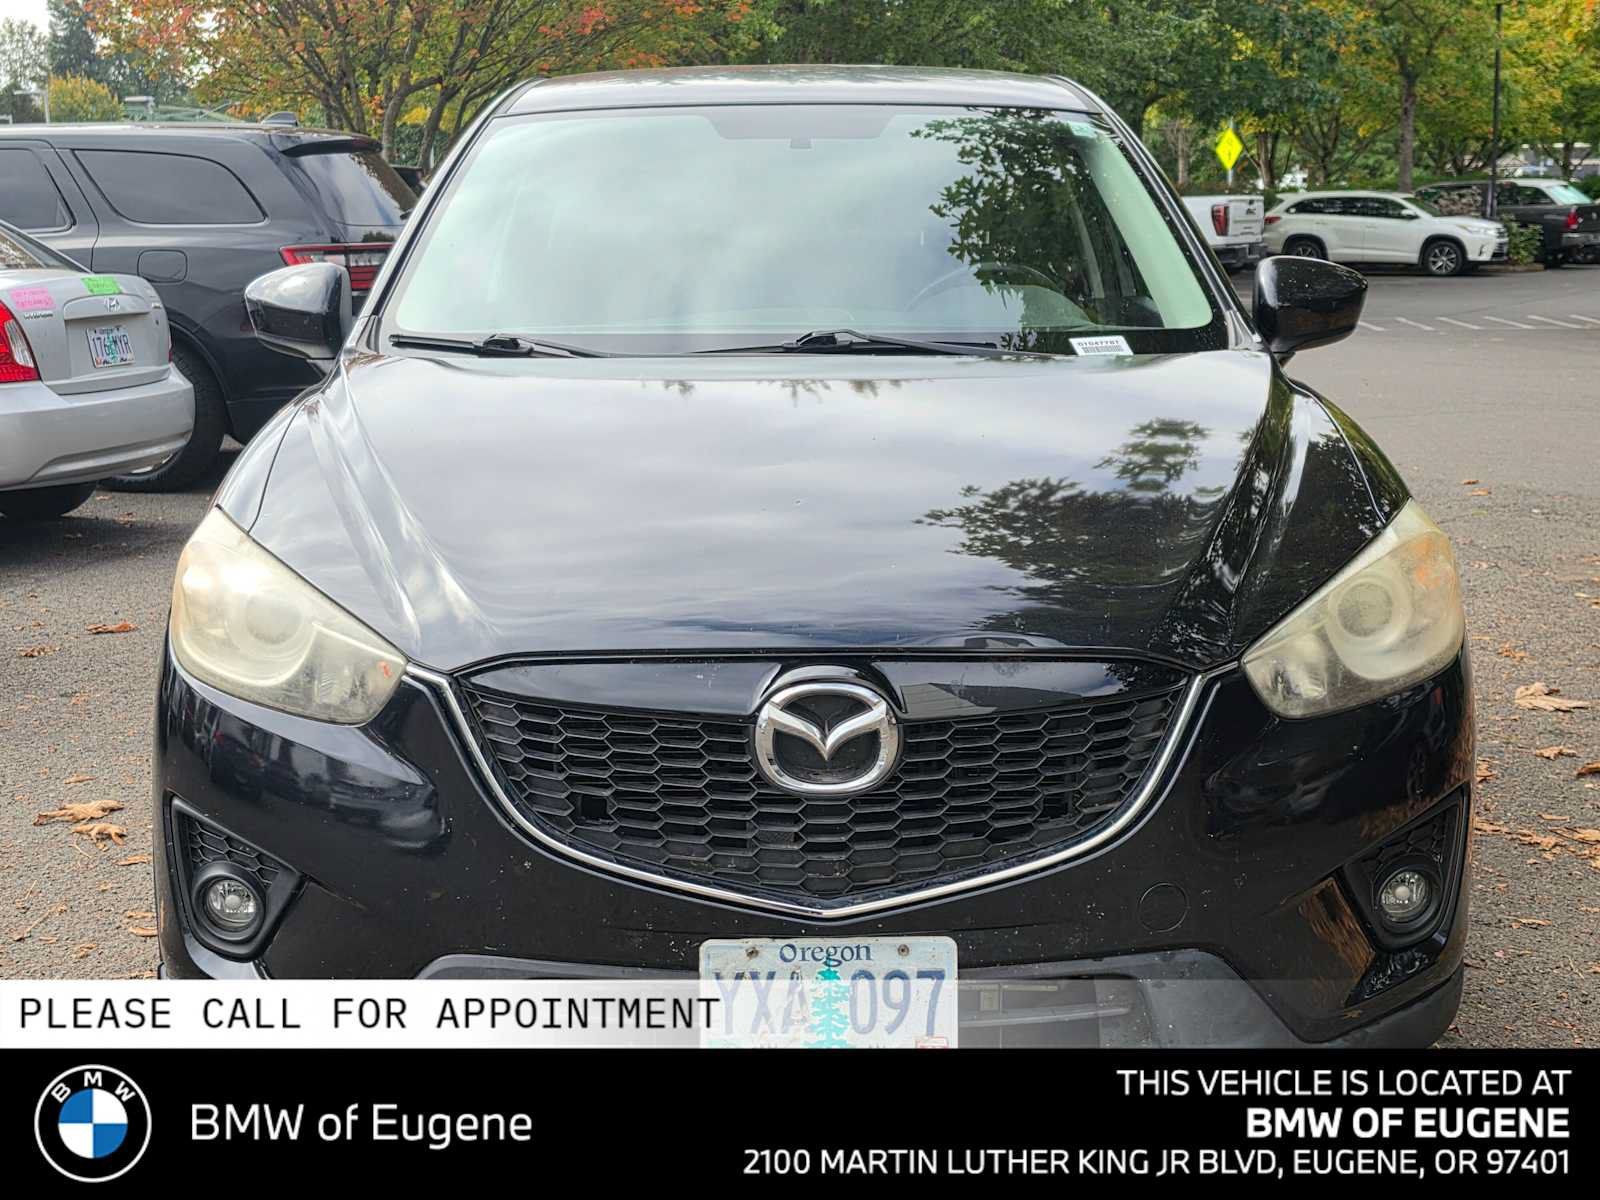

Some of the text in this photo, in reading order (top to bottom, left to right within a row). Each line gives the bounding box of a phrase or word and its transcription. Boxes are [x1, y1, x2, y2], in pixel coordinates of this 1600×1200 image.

[779, 942, 873, 967] Oregon
[714, 969, 946, 1037] YXA 097
